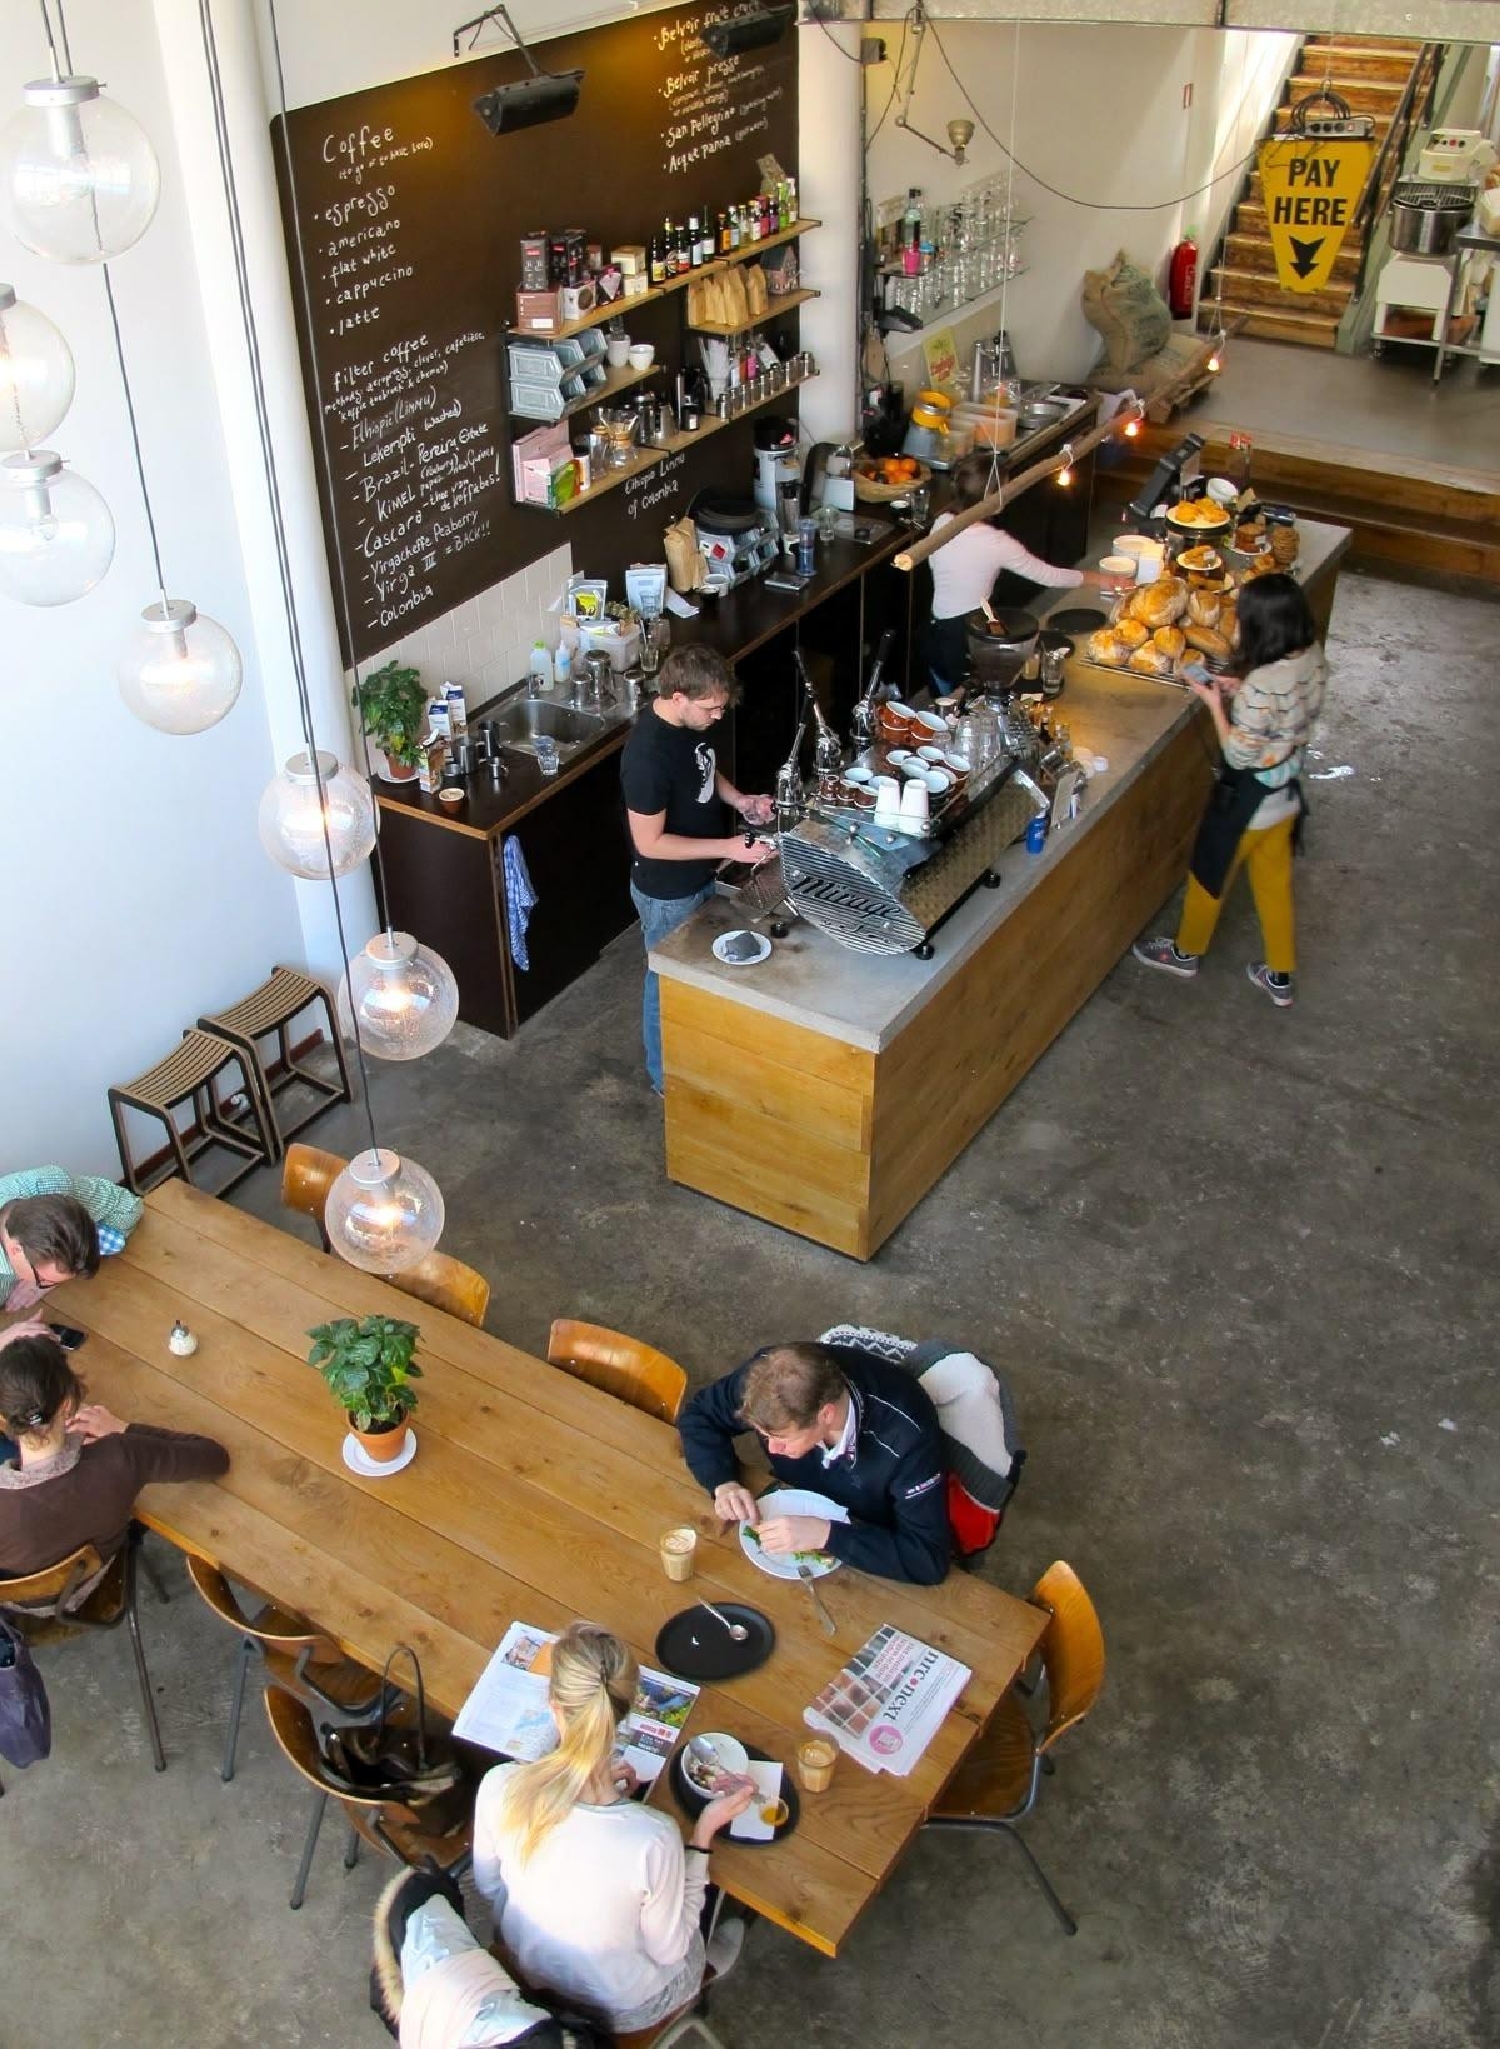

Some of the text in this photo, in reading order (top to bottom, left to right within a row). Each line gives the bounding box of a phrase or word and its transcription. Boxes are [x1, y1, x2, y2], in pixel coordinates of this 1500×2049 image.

[323, 125, 394, 164] Coffee
[666, 125, 688, 148] San
[690, 108, 735, 136] Pellegrino
[1288, 158, 1341, 187] PAY
[325, 185, 395, 226] espresso
[1273, 196, 1348, 226] HERE
[329, 219, 400, 256] americano
[330, 244, 396, 288] flat white
[337, 266, 413, 304] cappuccino
[339, 307, 380, 336] latte
[334, 334, 429, 391] filter coffee
[364, 510, 421, 558] Cascara
[376, 565, 415, 601] Yirga
[381, 585, 433, 626] Colombia
